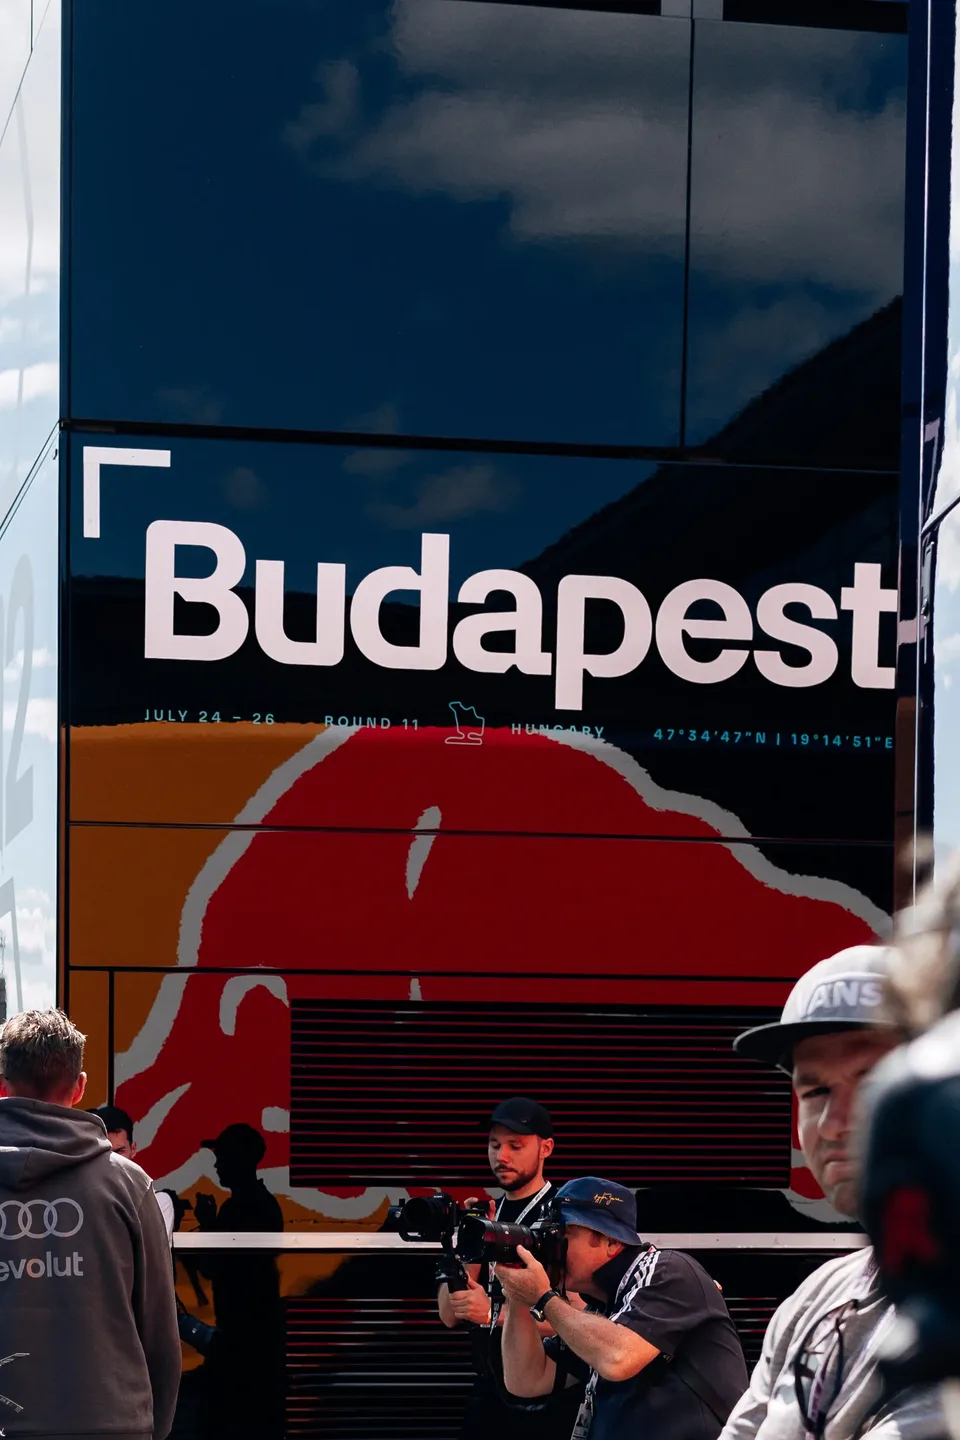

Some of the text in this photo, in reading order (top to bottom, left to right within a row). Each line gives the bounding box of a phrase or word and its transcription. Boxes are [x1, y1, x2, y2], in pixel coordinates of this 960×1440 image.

[144, 519, 898, 712] Budapest
[144, 709, 188, 722] JULY
[198, 711, 222, 723] 24
[252, 713, 275, 725] 26
[324, 715, 420, 731] ROUND 11
